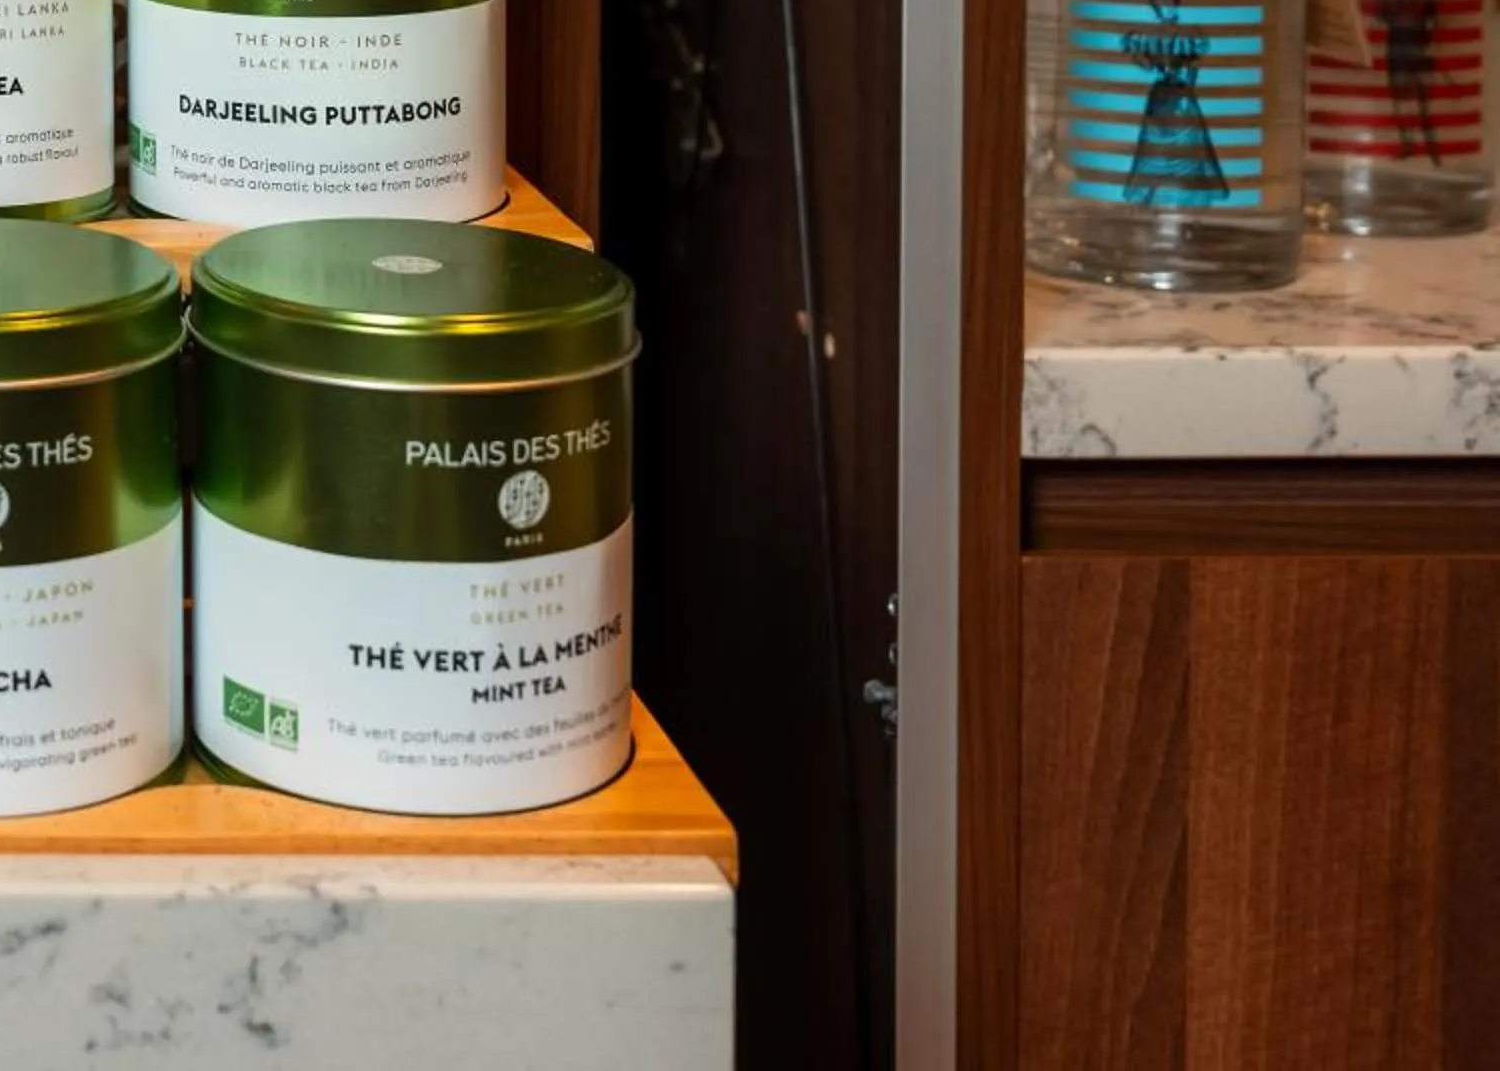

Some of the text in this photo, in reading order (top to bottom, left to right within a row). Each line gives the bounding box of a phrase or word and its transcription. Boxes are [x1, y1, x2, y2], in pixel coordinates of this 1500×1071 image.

[17, 1, 69, 16] LANKA
[21, 25, 65, 40] LANKA
[279, 35, 330, 48] NOIR
[357, 33, 403, 47] INDE
[239, 57, 399, 71] BLACK TEA INDIA
[179, 94, 461, 125] DARJEELING PUTTABONG
[6, 151, 43, 165] robust
[192, 151, 215, 163] noir
[218, 156, 235, 168] de
[239, 157, 315, 175] Darjeeling
[320, 160, 381, 176] puissant
[386, 160, 399, 172] et
[220, 176, 245, 189] and
[248, 179, 309, 193] aromatic
[313, 181, 351, 194] black
[355, 181, 378, 192] tea
[381, 178, 411, 192] from
[416, 170, 468, 189] Darjeeling
[26, 434, 93, 468] THÉS
[405, 419, 611, 468] PALAIS DES THÉS
[504, 533, 543, 548] PARIS
[22, 580, 94, 604] JAPON
[520, 573, 565, 593] VERT
[26, 610, 84, 628] JAPAN
[537, 602, 565, 618] TEA
[349, 613, 622, 673] THÉ VERT À LA MENTHE
[472, 676, 567, 704] MINT TEA
[0, 733, 35, 748] frais
[40, 730, 56, 745] et
[60, 718, 116, 741] tonique
[363, 728, 396, 741] vert
[481, 727, 520, 744] avec
[431, 753, 460, 767] tea
